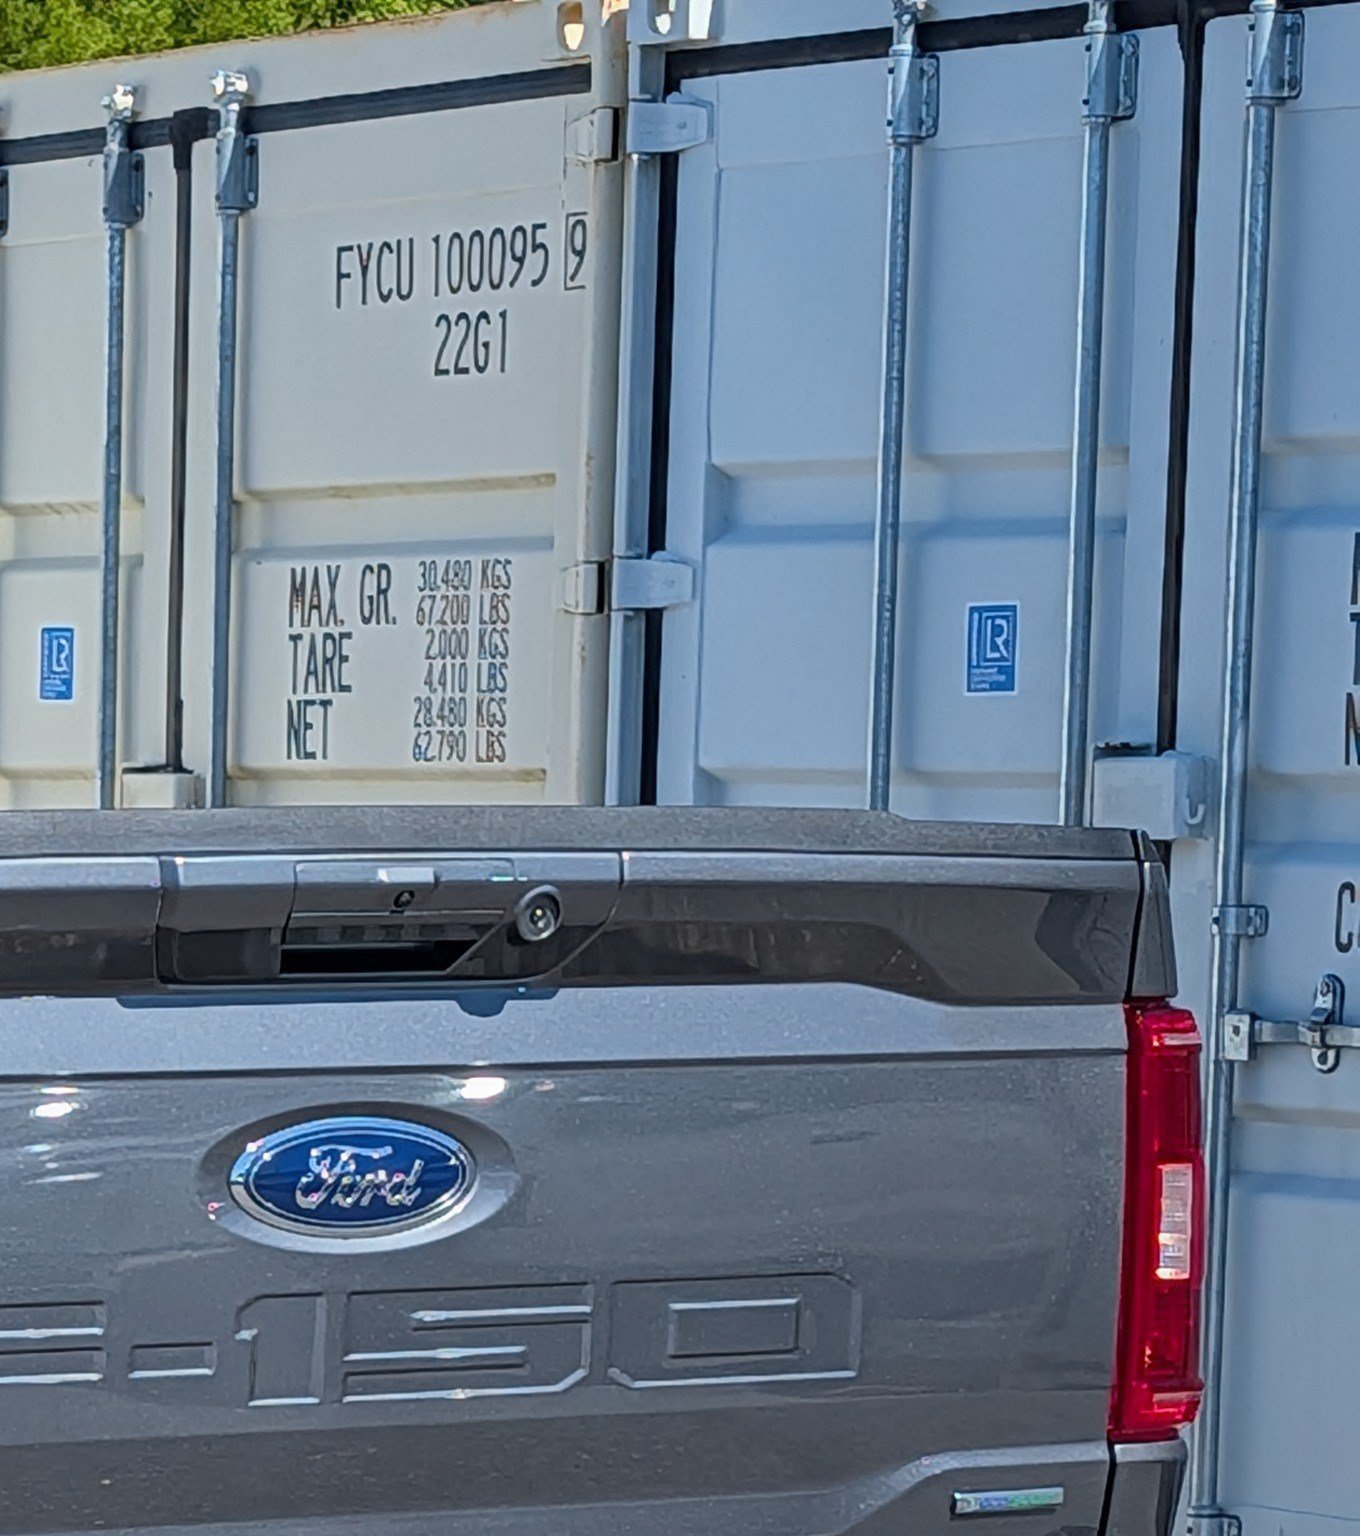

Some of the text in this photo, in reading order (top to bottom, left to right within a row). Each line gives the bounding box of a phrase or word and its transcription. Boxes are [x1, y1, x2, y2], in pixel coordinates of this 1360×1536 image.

[335, 216, 588, 309] FYCU 100095 9
[433, 308, 508, 377] 22G1
[288, 563, 397, 628] MAX. GR.
[480, 558, 513, 591] KGS
[478, 593, 511, 626] LBS
[288, 631, 353, 695] TARE
[477, 626, 510, 660] KGS
[476, 661, 508, 694] LBS
[286, 698, 333, 761] NET
[475, 695, 508, 729] KGS
[474, 730, 507, 764] LBS
[295, 1143, 425, 1210] Ford
